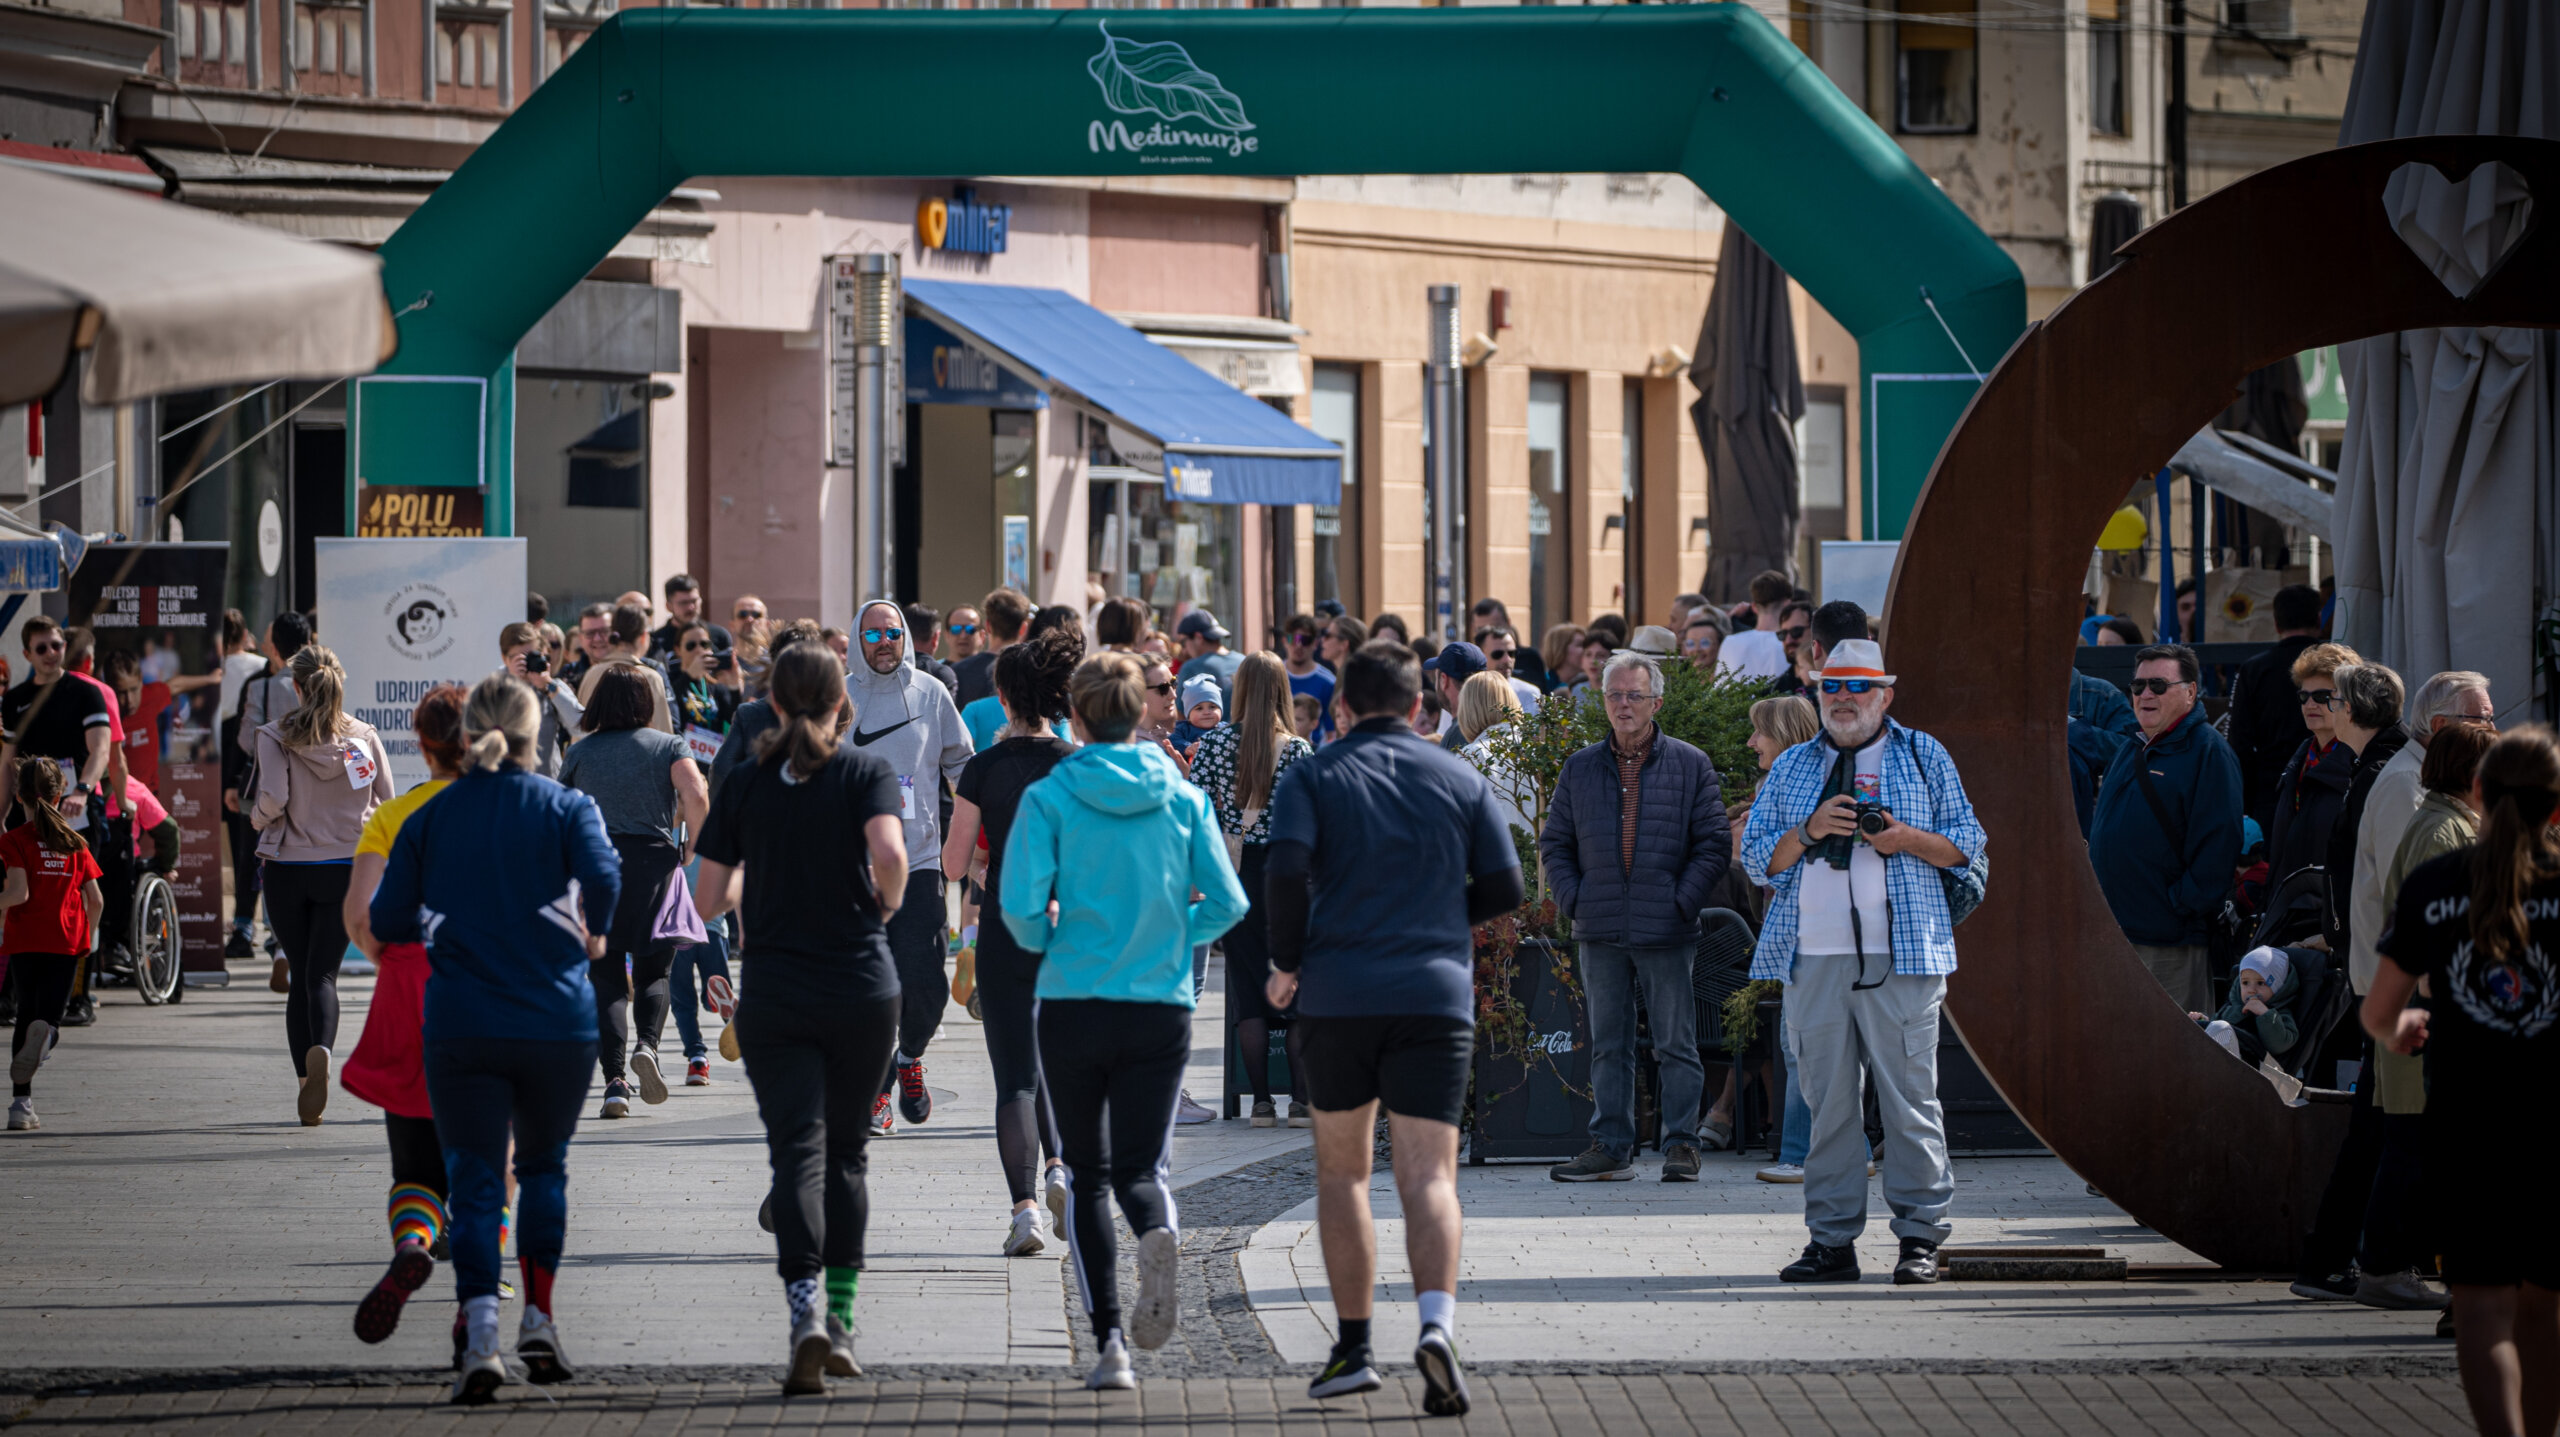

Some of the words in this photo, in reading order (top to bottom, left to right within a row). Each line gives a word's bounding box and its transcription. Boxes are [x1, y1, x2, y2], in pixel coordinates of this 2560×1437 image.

[1088, 119, 1258, 157] Međimurje
[382, 493, 456, 527] POLU
[101, 586, 140, 599] ATLETSKI
[158, 586, 198, 599] ATHLETIC
[117, 600, 140, 612] KLUB
[158, 600, 181, 612] CLUB
[375, 680, 438, 703] UDRUG
[354, 708, 415, 731] SINDRO
[44, 860, 65, 868] QUIT
[2424, 895, 2560, 926] CHAON
